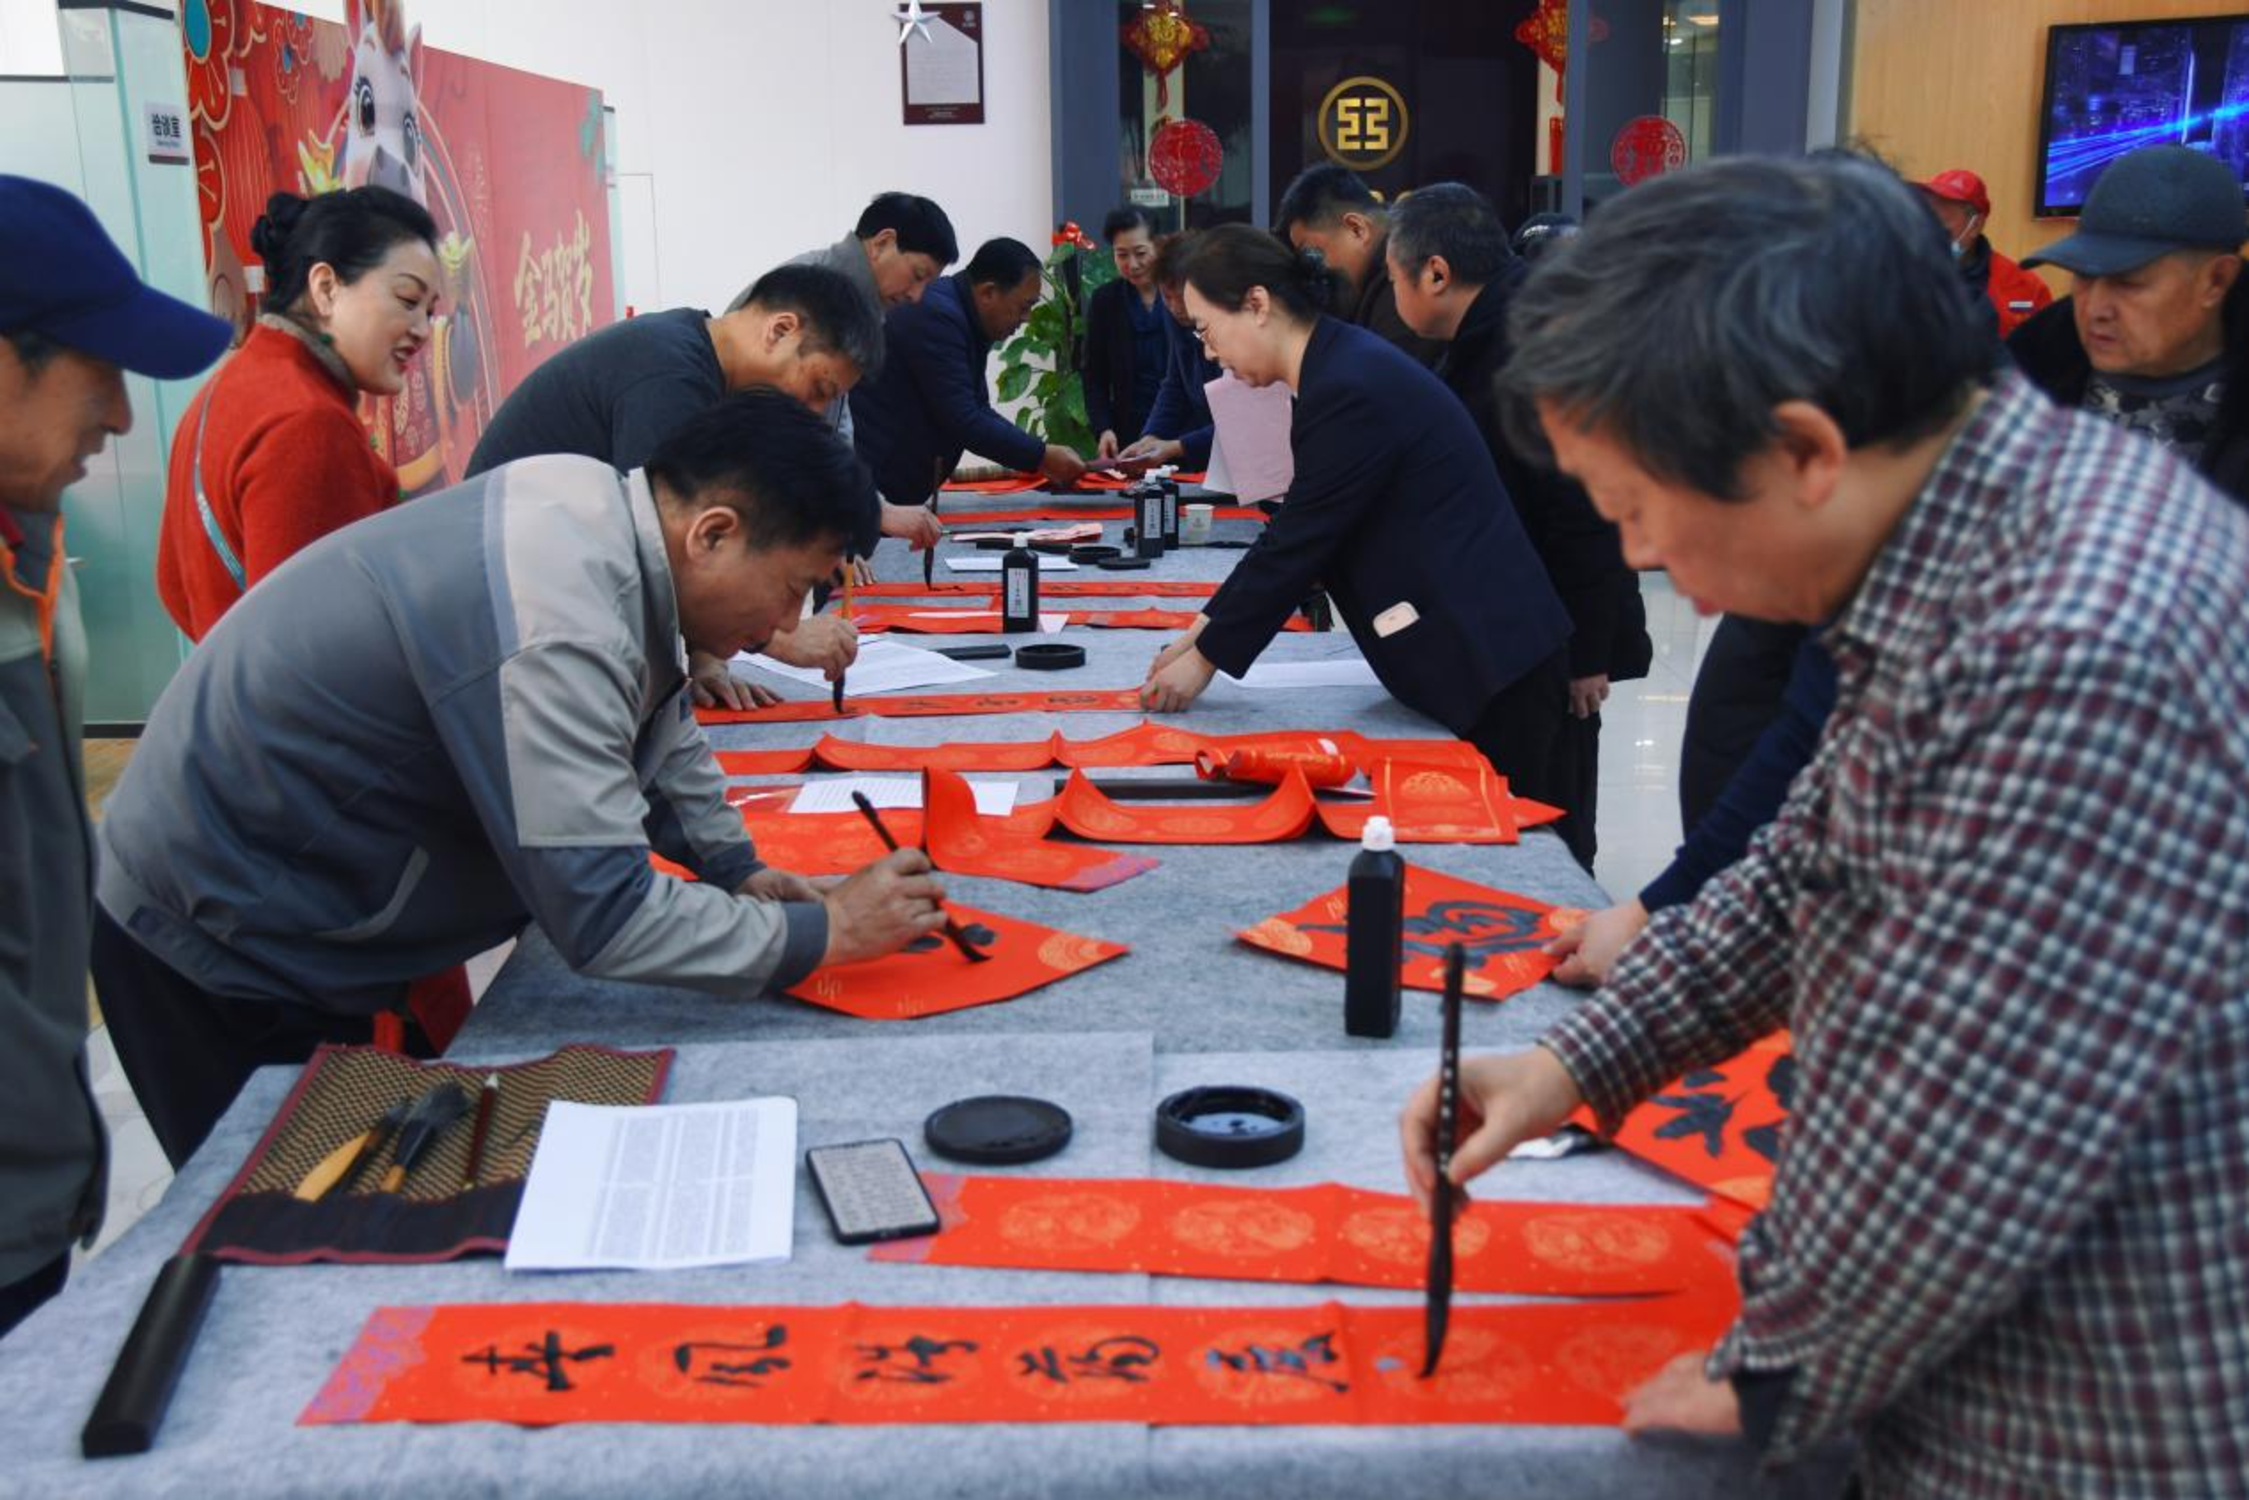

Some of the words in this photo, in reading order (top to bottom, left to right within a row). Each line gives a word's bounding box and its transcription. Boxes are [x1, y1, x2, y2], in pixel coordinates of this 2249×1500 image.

[151, 113, 181, 138] 洽谈室
[514, 207, 593, 349] 金马贺岁
